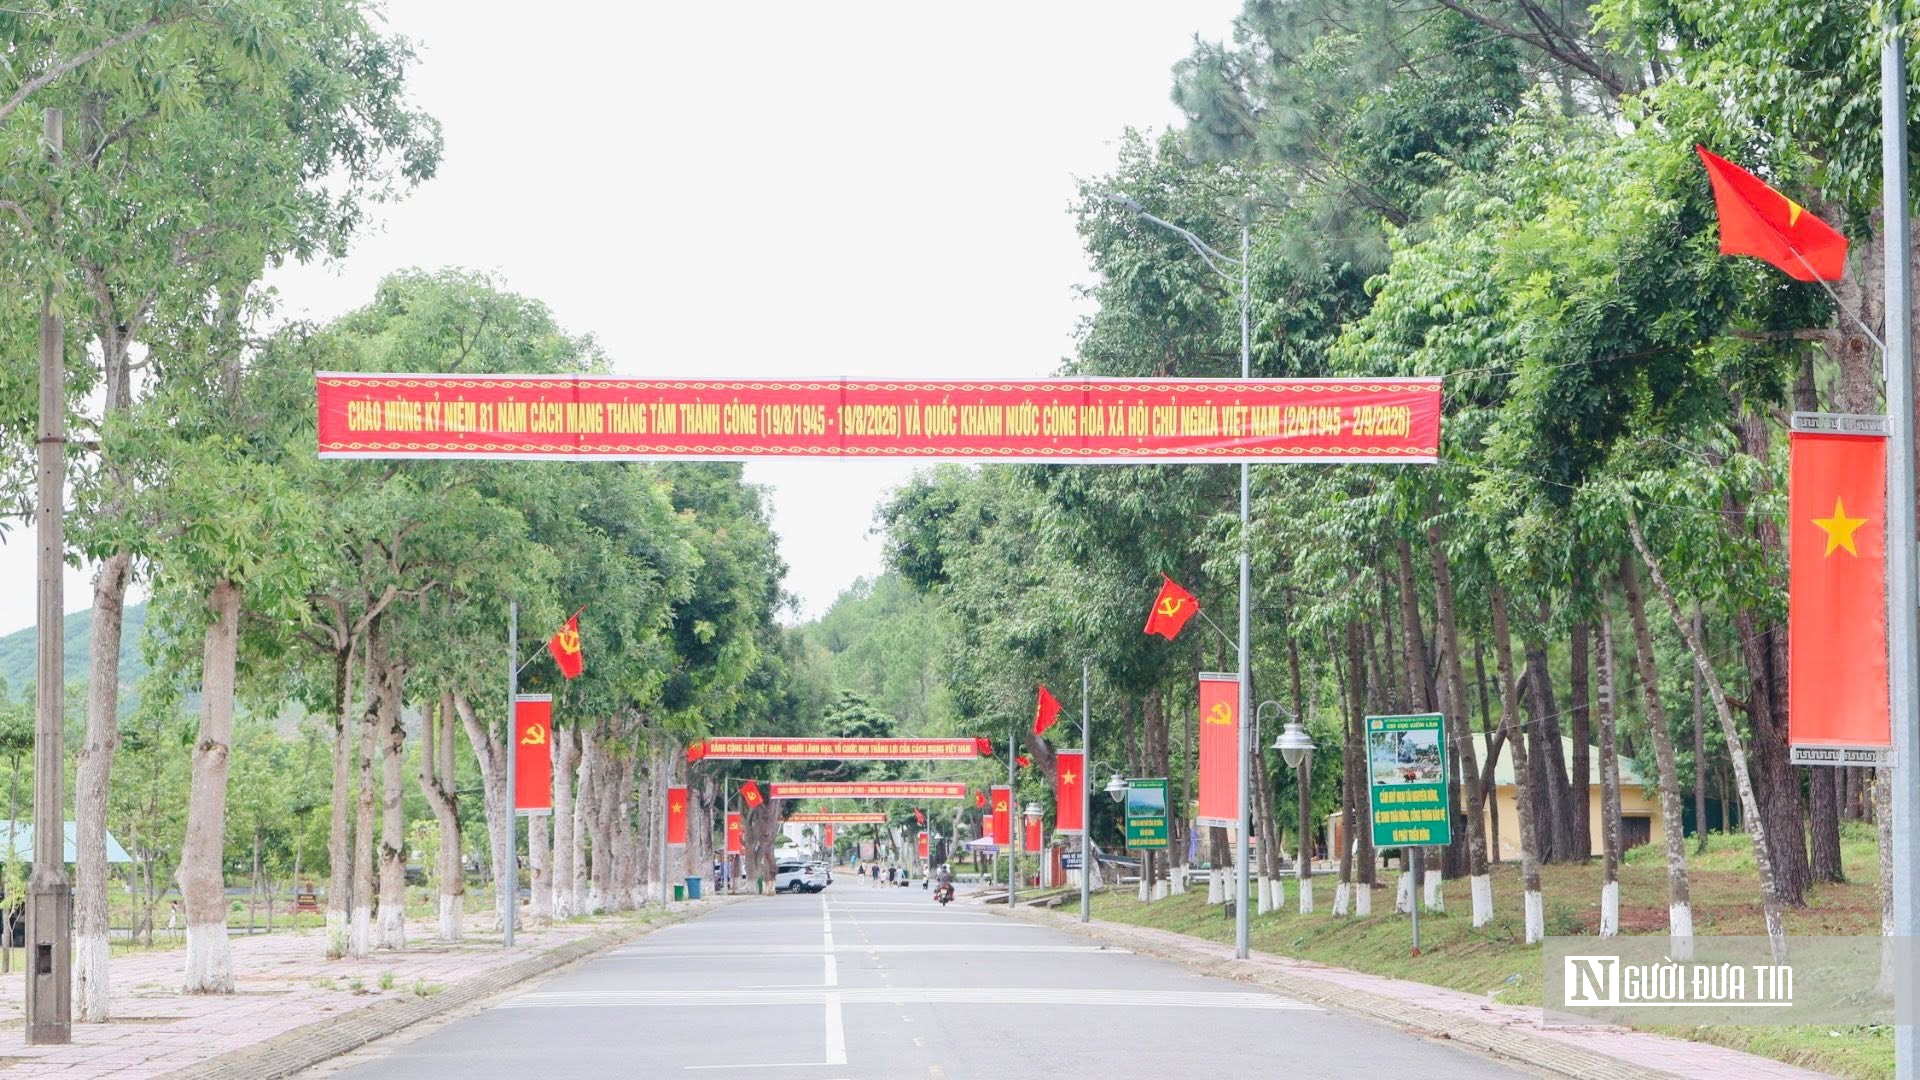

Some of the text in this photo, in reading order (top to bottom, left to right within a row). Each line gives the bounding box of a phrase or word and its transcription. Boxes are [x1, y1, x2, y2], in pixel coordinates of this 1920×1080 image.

[347, 394, 382, 432] CHÀO
[384, 395, 422, 432] MỪNG
[425, 391, 441, 432] KỶ
[444, 395, 477, 438] NIỆM
[479, 402, 493, 432] 81
[497, 395, 527, 433] NĂM
[530, 395, 563, 433] CÁCH
[567, 402, 603, 440] MẠNG
[606, 396, 647, 434] THÁNG
[650, 396, 677, 434] TÁM
[679, 397, 720, 435] THÀNH
[723, 397, 757, 435] CÔNG
[761, 403, 825, 438] (19/8/1945
[838, 404, 902, 438] 19/8/2026)
[904, 398, 921, 435] VÀ
[924, 394, 957, 437] QUỐC
[961, 399, 1002, 436] KHÁNH
[1006, 399, 1039, 436] NƯỚC
[1043, 399, 1076, 442] CỘNG
[1080, 400, 1104, 436] HOÀ
[1108, 400, 1125, 436] XÃ
[1128, 399, 1149, 443] HỘI
[1152, 395, 1177, 436] CHỦ
[1180, 399, 1219, 436] NGHĨA
[1222, 399, 1249, 443] VIỆT
[1251, 405, 1280, 436] NAM
[1284, 405, 1341, 438] (2/9/1945
[1352, 405, 1411, 438] 2/9/2026)
